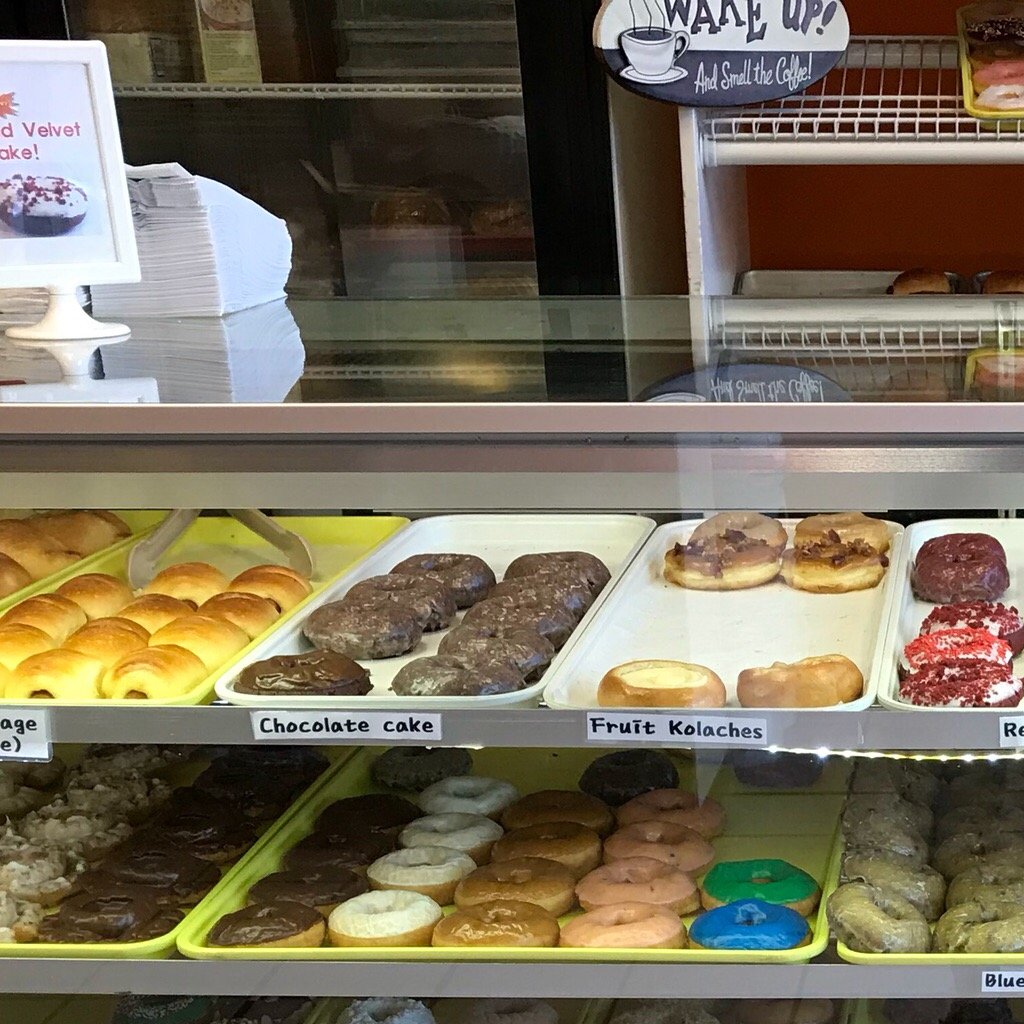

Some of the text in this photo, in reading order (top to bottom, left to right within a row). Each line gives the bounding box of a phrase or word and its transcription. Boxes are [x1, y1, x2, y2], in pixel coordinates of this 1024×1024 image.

[782, 0, 838, 35] UP!
[694, 52, 813, 94] And Smell the Coffee!
[22, 121, 81, 138] Velvet
[259, 717, 434, 733] Chocolate cake
[669, 720, 763, 739] Kolaches
